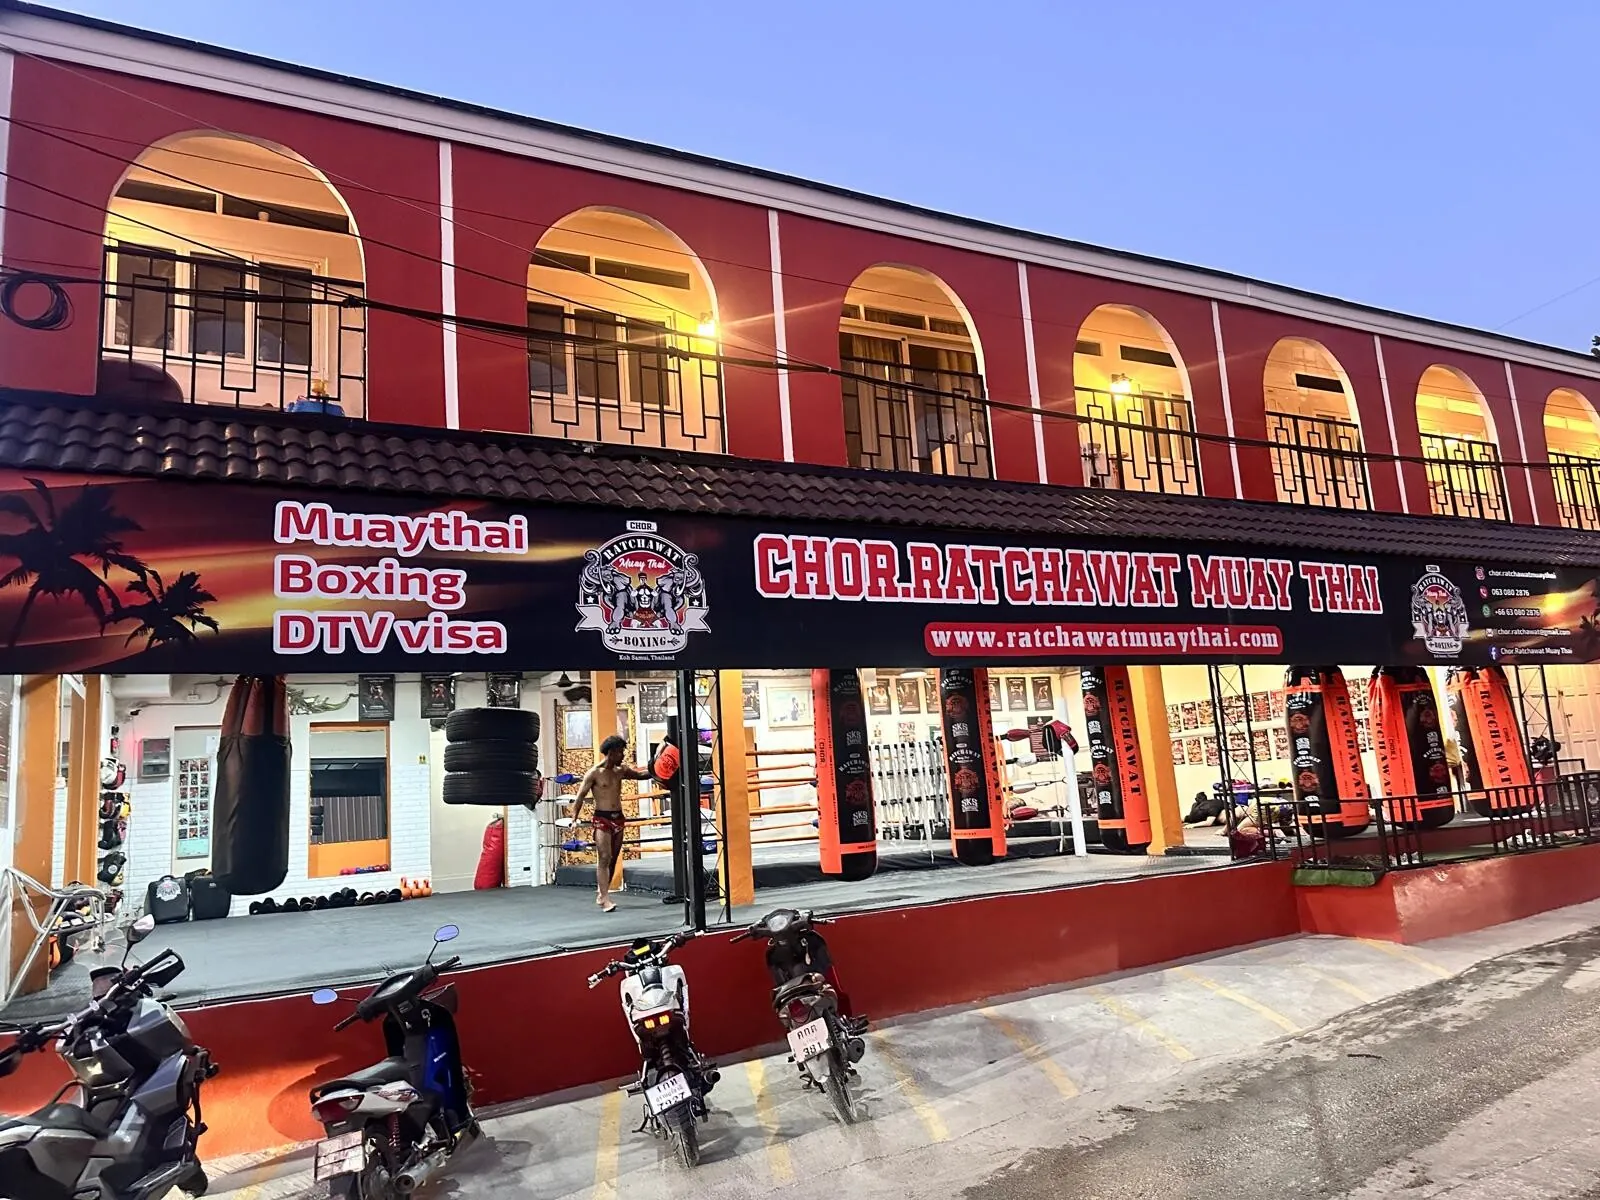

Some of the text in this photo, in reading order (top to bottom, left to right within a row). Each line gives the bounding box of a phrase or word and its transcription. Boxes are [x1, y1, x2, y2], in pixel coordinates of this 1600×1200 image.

[274, 501, 529, 555] Muaythai
[603, 538, 682, 561] RATCHAWAT
[274, 554, 466, 611] Boxing
[618, 558, 666, 571] Muay Thai
[754, 534, 1384, 615] CHOR.RATCHAWAT MUAY THAI
[274, 610, 507, 654] DTV visa
[624, 636, 666, 648] BOXING
[930, 625, 1279, 652] www.ratchawatmuaythai.com
[1114, 679, 1142, 795] RATCHAWAT
[1479, 690, 1513, 785] RATCHAWAT
